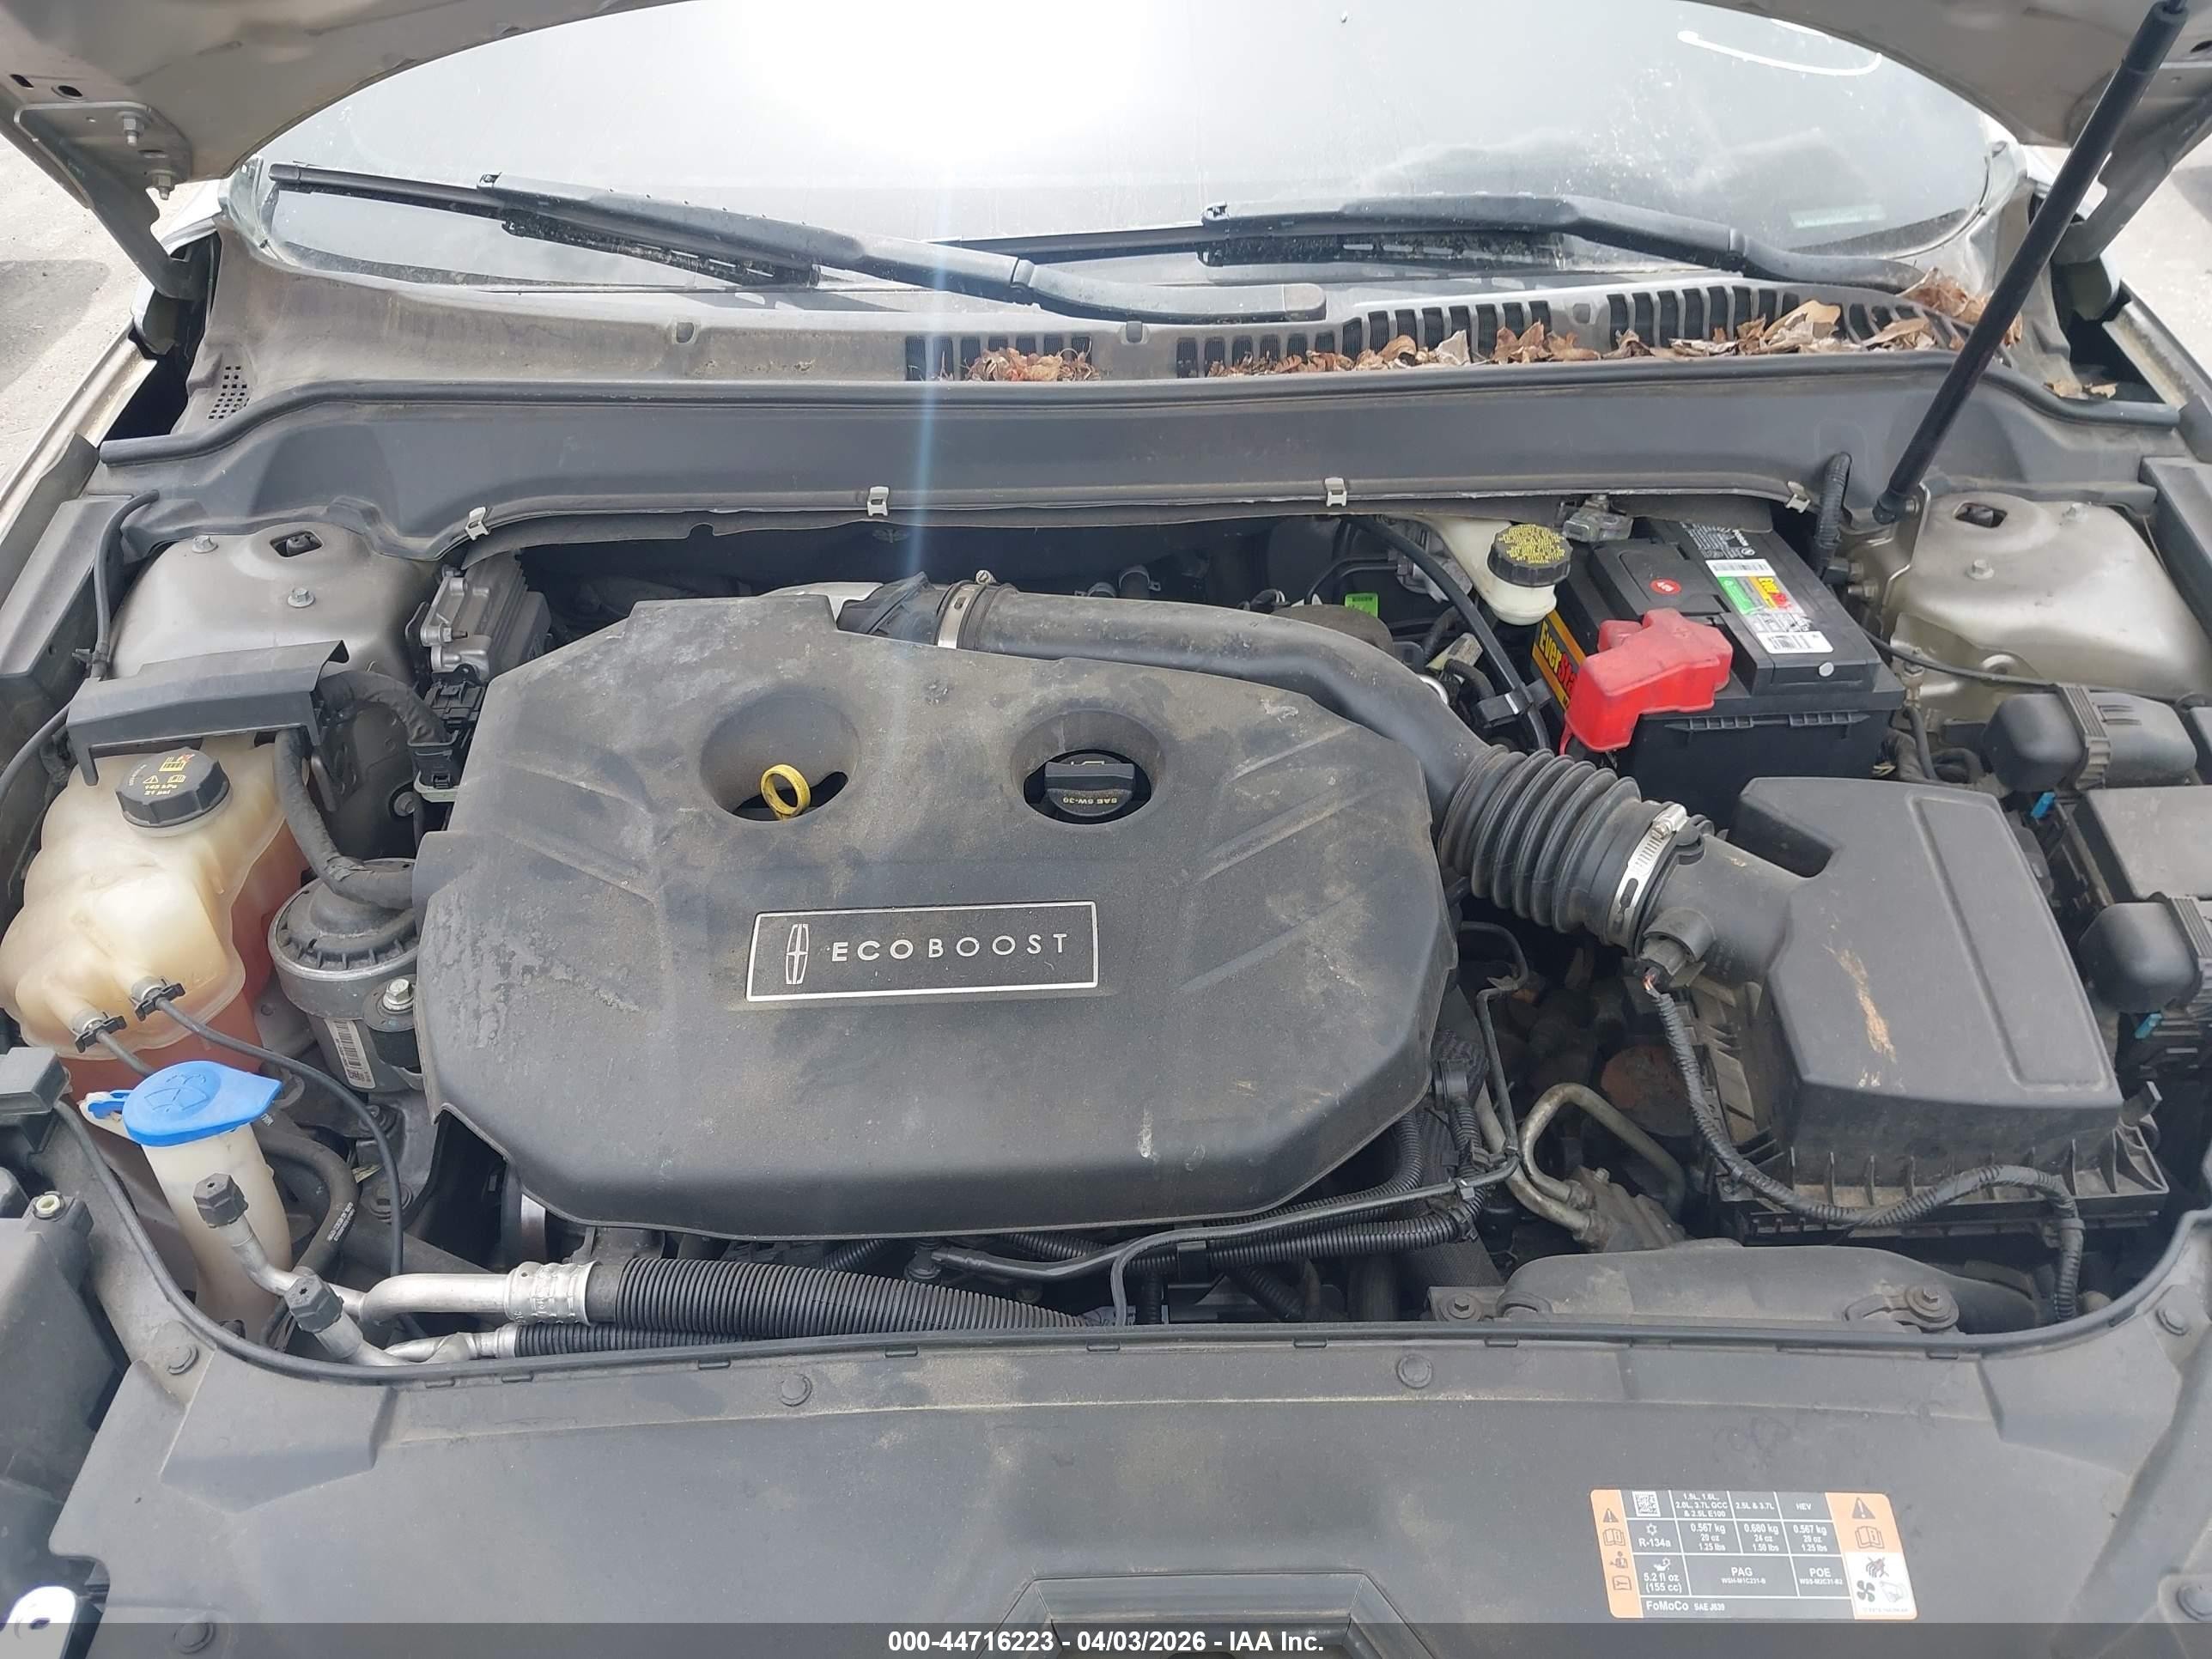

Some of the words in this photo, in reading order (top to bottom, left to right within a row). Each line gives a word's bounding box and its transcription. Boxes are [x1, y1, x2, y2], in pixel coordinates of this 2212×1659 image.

[831, 933, 1067, 962] ECOBOOST
[1690, 1522, 1712, 1533] 0.567
[1714, 1522, 1726, 1534] kg
[1743, 1523, 1766, 1534] 0.680
[1767, 1523, 1779, 1535] kg
[1793, 1524, 1814, 1534] 0.567
[1815, 1524, 1827, 1536] kg
[1638, 1537, 1672, 1547] R-134a
[1700, 1533, 1710, 1542] 20
[1753, 1534, 1763, 1543] 24
[1698, 1542, 1713, 1552] 1.25
[1714, 1542, 1726, 1552] lbs
[1753, 1543, 1767, 1553] 1.50
[1768, 1543, 1779, 1553] lbs
[1802, 1544, 1816, 1553] 1.25
[1817, 1543, 1828, 1553] lbs
[1730, 1566, 1753, 1577] PAG
[1809, 1567, 1832, 1577] POE
[1644, 1572, 1657, 1582] 5.2
[1659, 1572, 1666, 1583] fl
[1645, 1582, 1666, 1594] (155
[1668, 1582, 1682, 1594] cc)
[1645, 1600, 1689, 1612] FoMoCo
[1693, 1602, 1709, 1612] SAE
